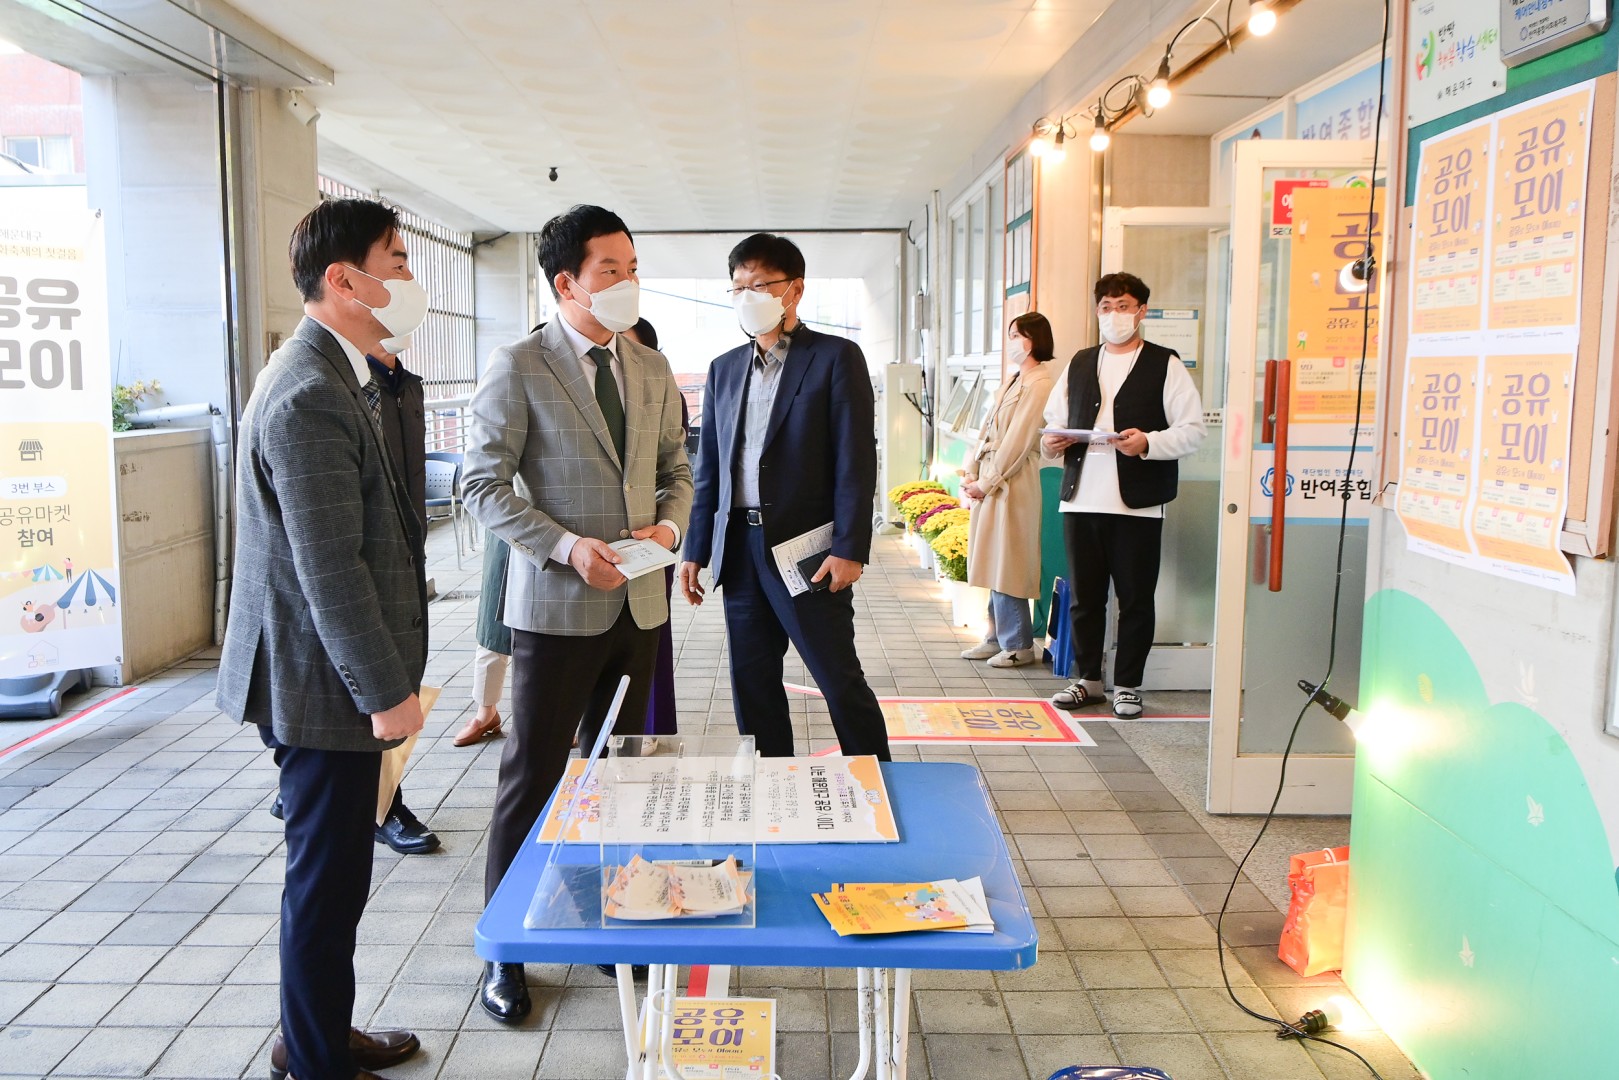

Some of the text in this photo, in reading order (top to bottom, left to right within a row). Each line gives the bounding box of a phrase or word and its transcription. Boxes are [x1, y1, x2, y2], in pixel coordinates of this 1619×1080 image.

[1302, 94, 1389, 140] 반여종합
[1514, 117, 1567, 173] 공유
[1434, 147, 1473, 195] 공유
[1510, 168, 1564, 221] 모이
[1430, 193, 1471, 238] 모이
[1421, 372, 1462, 412] 공유
[1501, 372, 1551, 417] 공유
[1419, 417, 1460, 454] 모이
[1497, 423, 1549, 464] 모이
[11, 482, 56, 494] 3번 부스
[0, 504, 71, 526] 공유마켓
[17, 527, 54, 548] 참여
[957, 707, 1002, 730] 모이
[996, 708, 1042, 730] 공유
[810, 765, 827, 776] 나는
[812, 777, 831, 799] 해운대구
[674, 1008, 745, 1026] 공유
[672, 1028, 744, 1047] 모이
